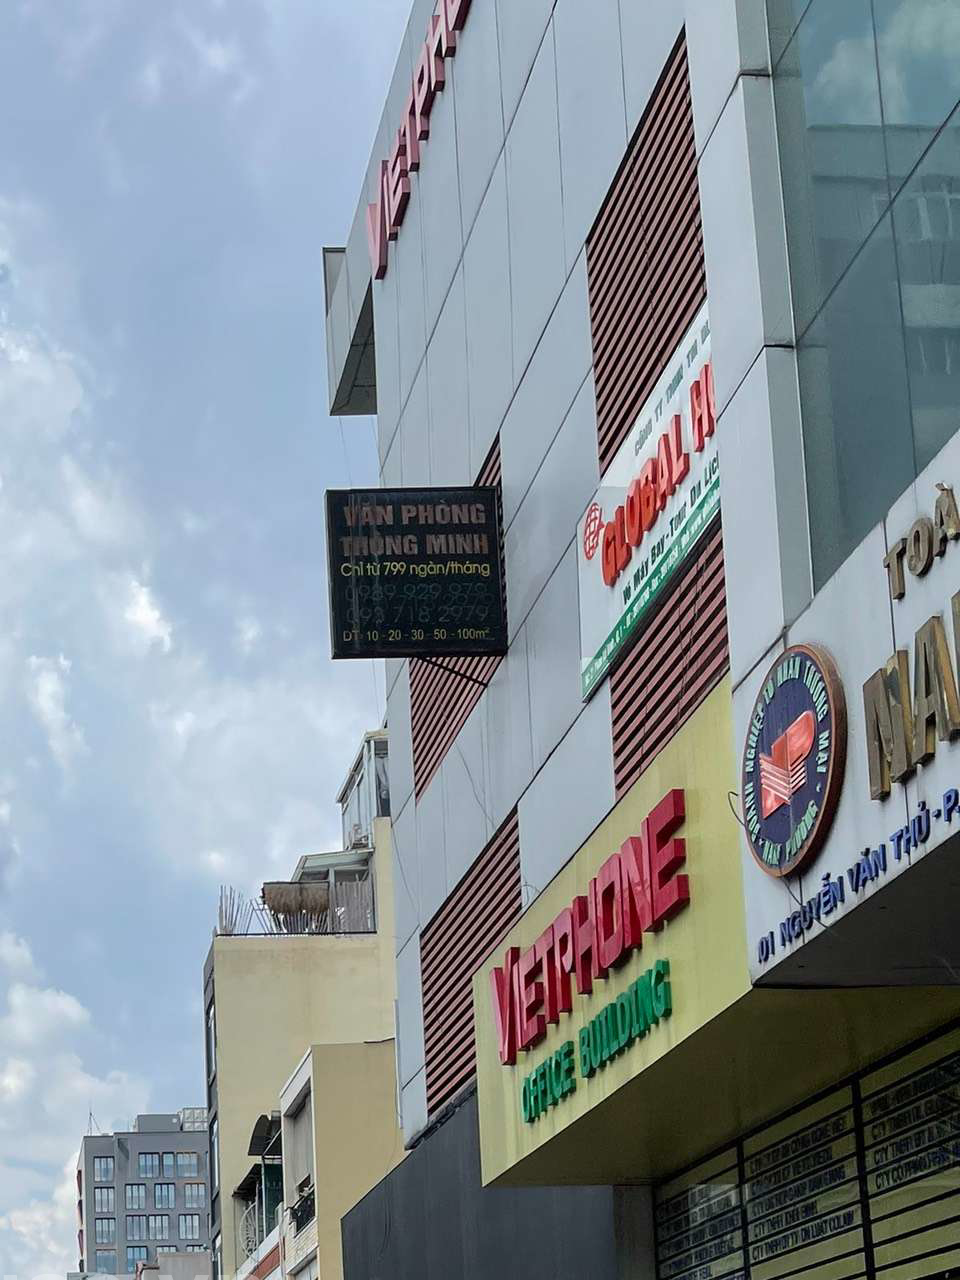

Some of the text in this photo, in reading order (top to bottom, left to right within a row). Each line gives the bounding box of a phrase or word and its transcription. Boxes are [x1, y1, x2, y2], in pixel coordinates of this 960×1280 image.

[401, 500, 487, 524] PHÒNG
[426, 533, 490, 556] MINH
[602, 414, 690, 588] GLOBAL
[383, 562, 407, 576] 799
[409, 560, 491, 577] ngàn/tháng
[367, 631, 379, 641] 10
[388, 631, 402, 641] 20
[411, 630, 425, 641] 30
[433, 629, 447, 640] 50
[862, 590, 960, 801] NA
[847, 847, 887, 894] VĂN
[890, 801, 930, 861] THỦ
[489, 788, 690, 1066] VIETPHONE
[522, 958, 672, 1123] OFFICE BUILDING
